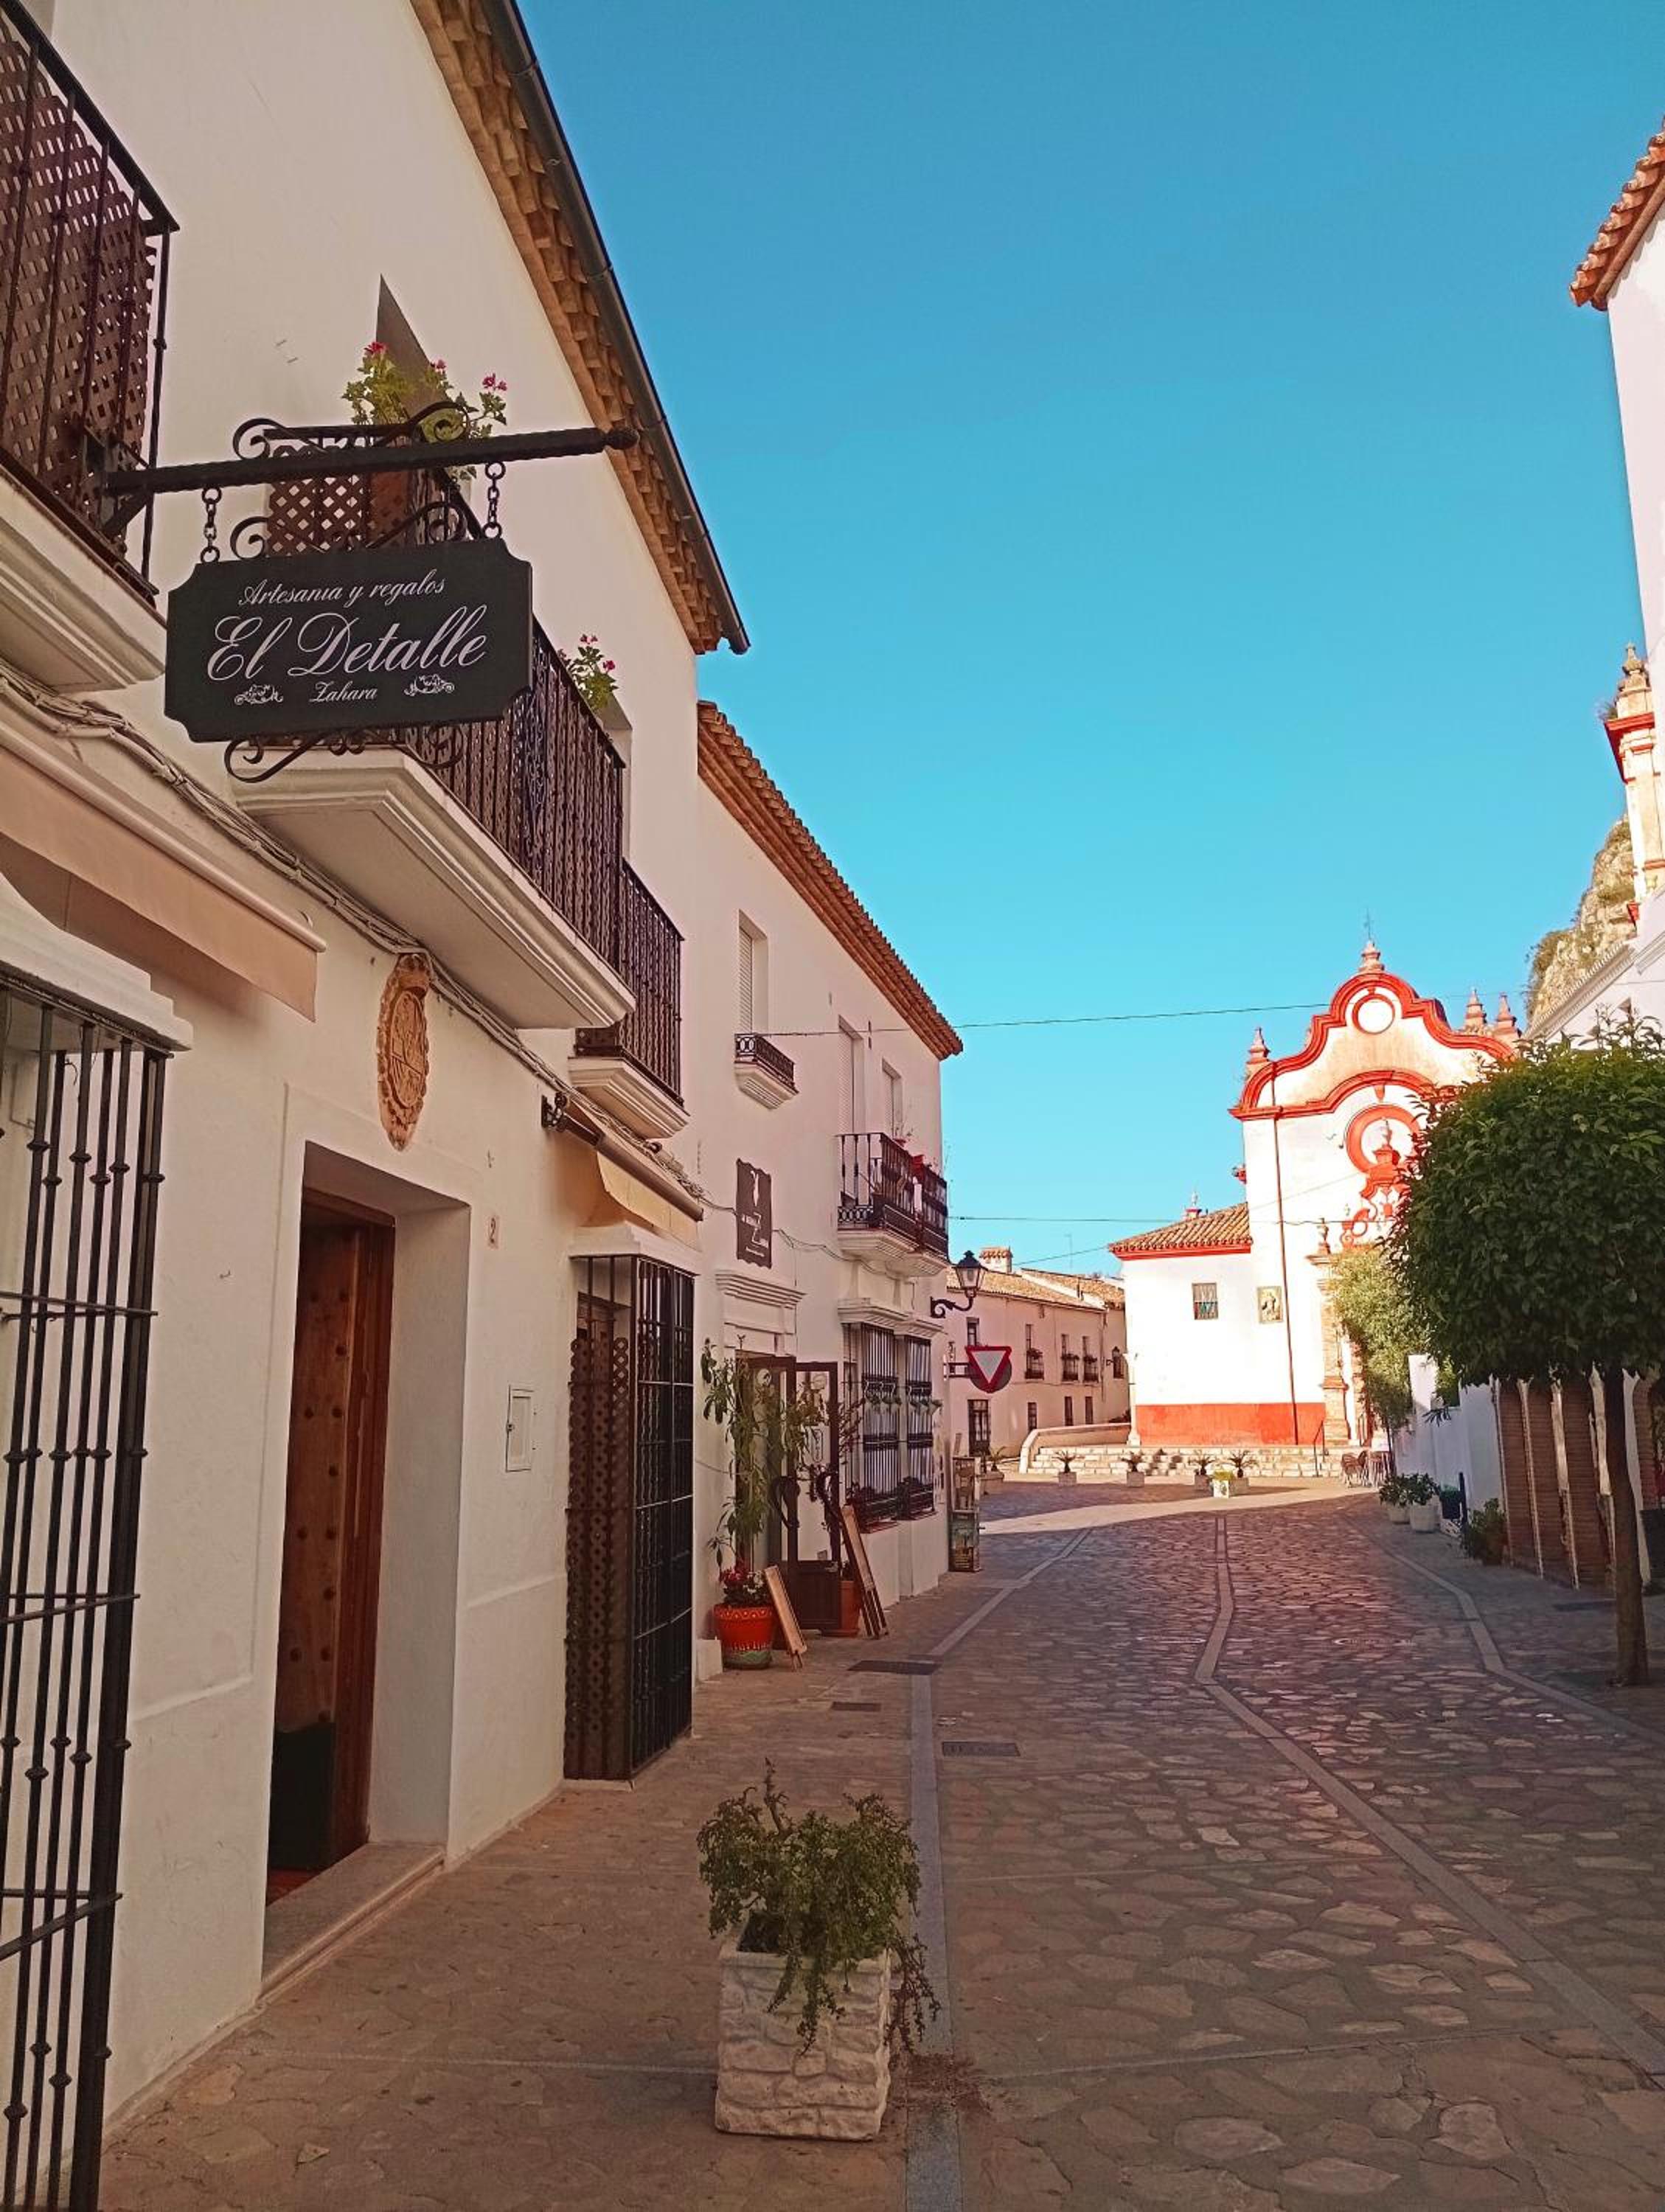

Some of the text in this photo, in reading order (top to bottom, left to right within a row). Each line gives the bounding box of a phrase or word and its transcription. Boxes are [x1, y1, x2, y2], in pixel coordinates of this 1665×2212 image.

[343, 585, 364, 608] y
[369, 568, 445, 606] regalos
[207, 605, 487, 681] El Detalle
[309, 681, 378, 702] Zahara
